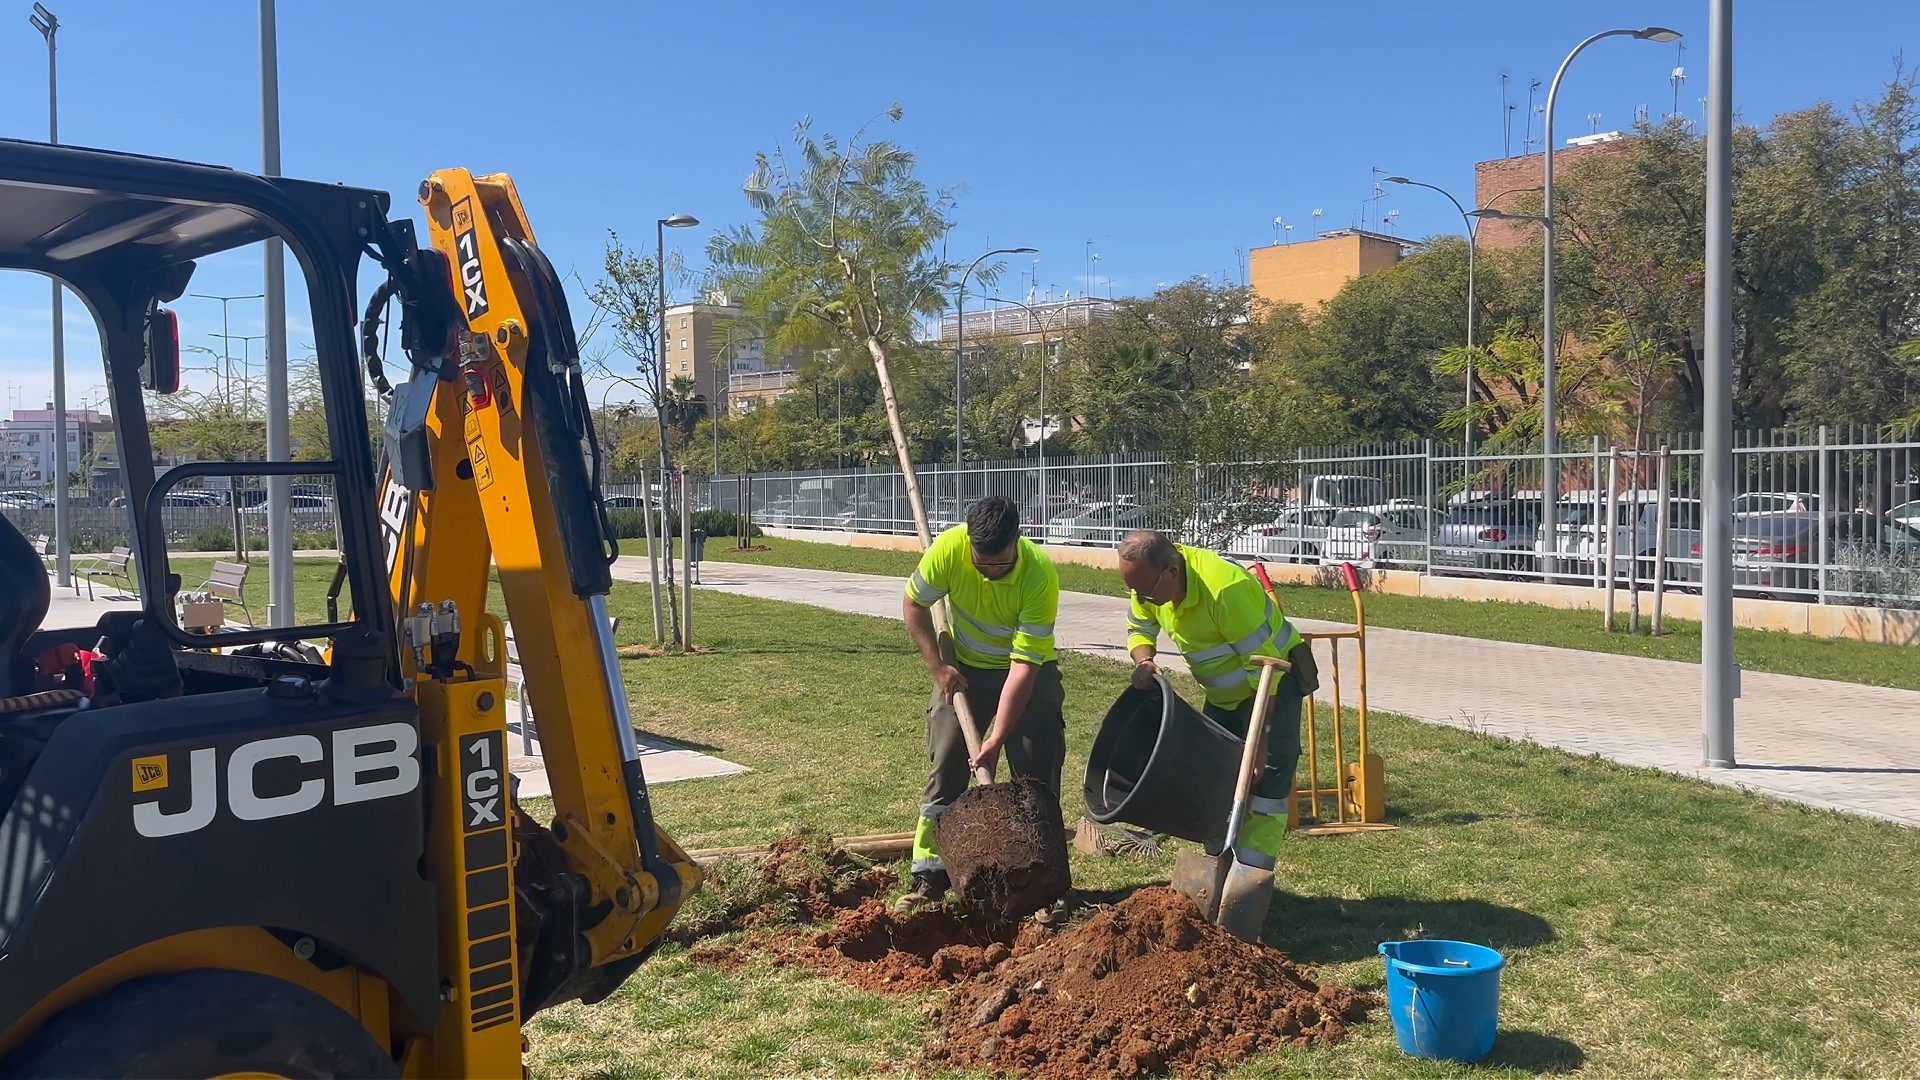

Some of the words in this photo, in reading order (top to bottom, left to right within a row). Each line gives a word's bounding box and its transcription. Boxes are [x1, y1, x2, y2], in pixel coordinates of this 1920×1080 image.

[459, 233, 487, 314] 1CX
[133, 722, 420, 838] JCB
[139, 765, 162, 782] JCB
[467, 738, 500, 826] 1CX
